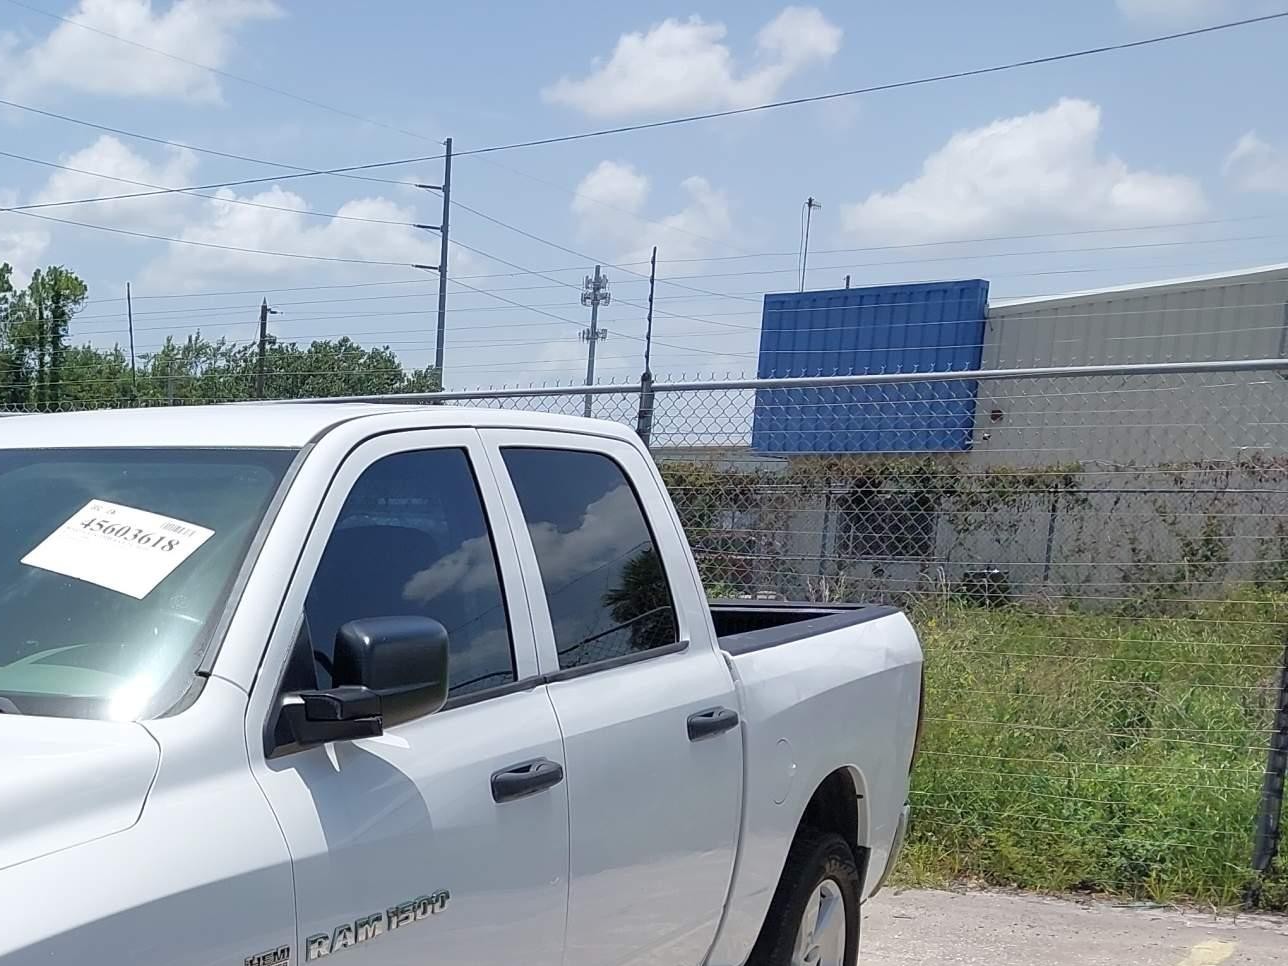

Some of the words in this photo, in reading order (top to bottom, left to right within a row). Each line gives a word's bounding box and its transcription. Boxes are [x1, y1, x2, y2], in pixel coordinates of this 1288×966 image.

[80, 517, 180, 552] 45603618
[306, 912, 384, 962] RAM
[386, 888, 451, 931] 1500
